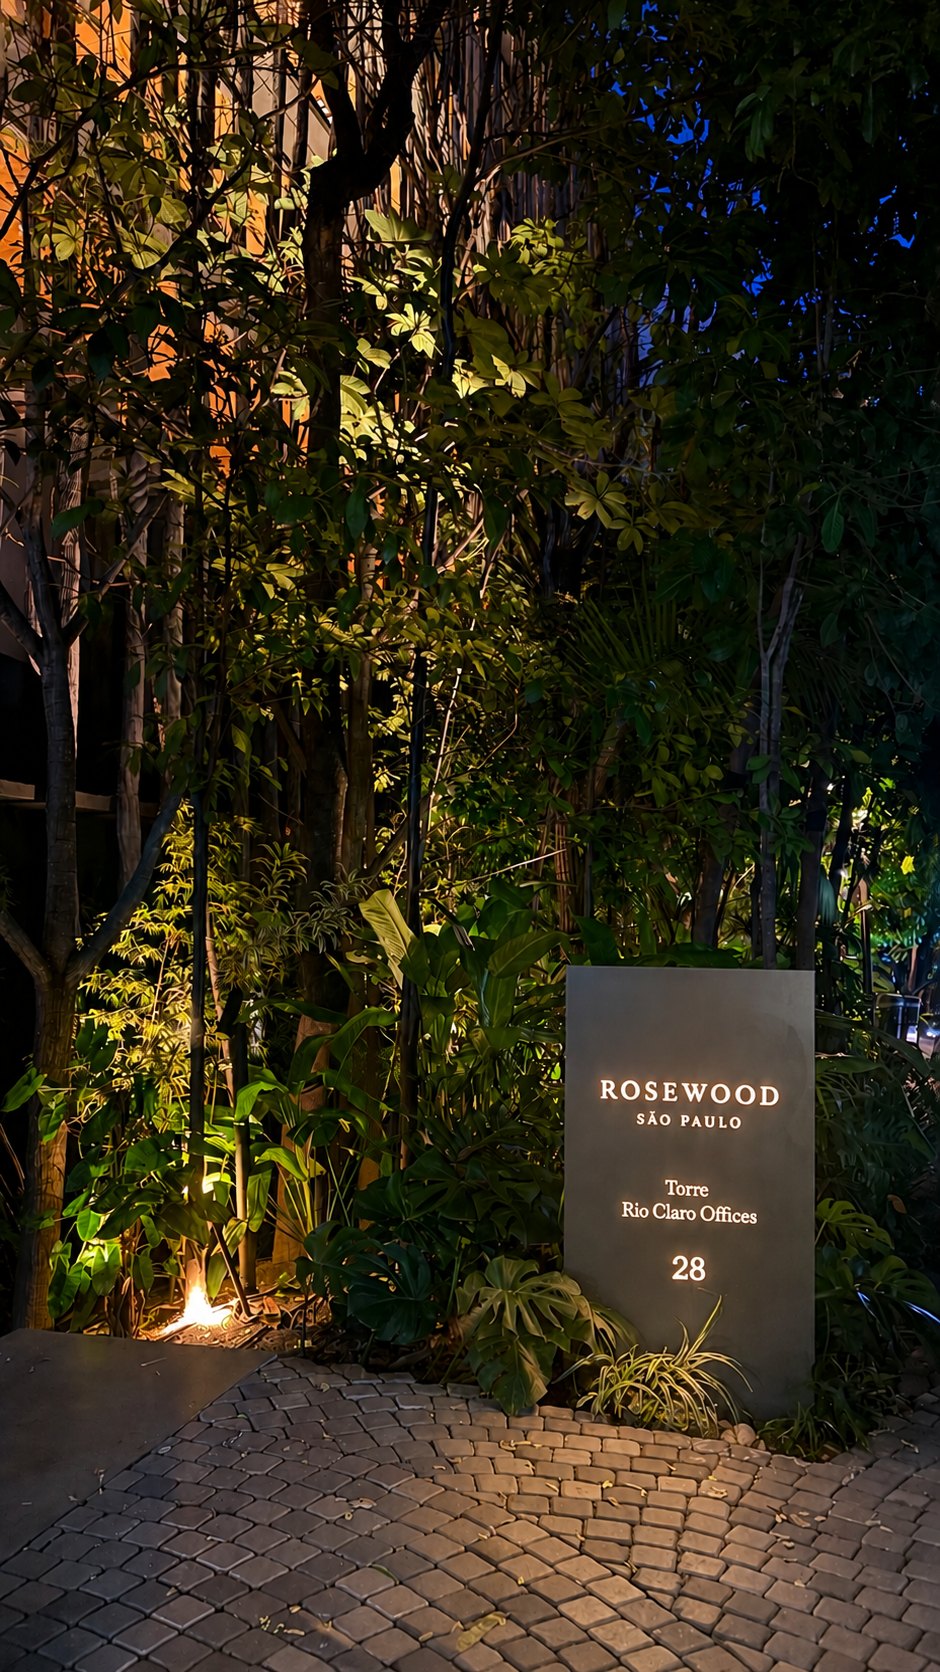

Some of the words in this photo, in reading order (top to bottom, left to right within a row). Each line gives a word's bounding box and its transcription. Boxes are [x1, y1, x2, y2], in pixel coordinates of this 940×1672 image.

[600, 1080, 779, 1105] ROSEWOOD
[637, 1111, 671, 1125] SÃO
[681, 1115, 741, 1129] PAULO
[665, 1180, 708, 1197] Torre
[622, 1202, 649, 1218] Rio
[653, 1203, 696, 1220] Claro
[700, 1206, 757, 1224] Offices
[672, 1255, 705, 1281] 28
